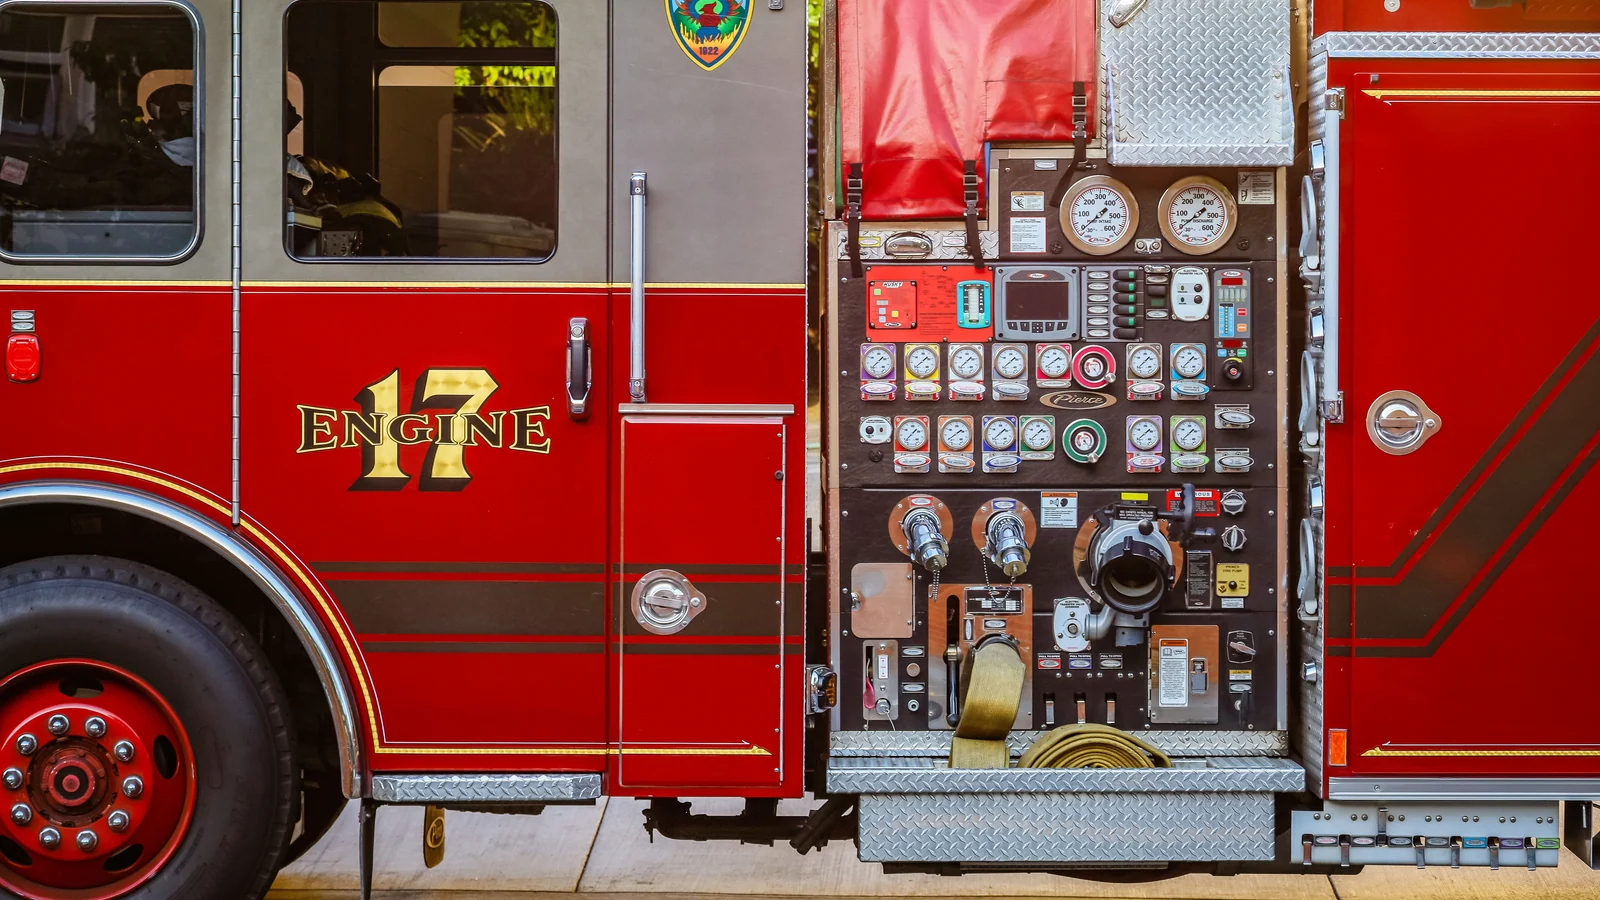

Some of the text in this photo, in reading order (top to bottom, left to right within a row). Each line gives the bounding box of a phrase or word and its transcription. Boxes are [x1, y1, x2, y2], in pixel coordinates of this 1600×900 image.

[1054, 394, 1103, 404] Pierce
[296, 404, 551, 454] ENGINE
[351, 366, 500, 488] 17
